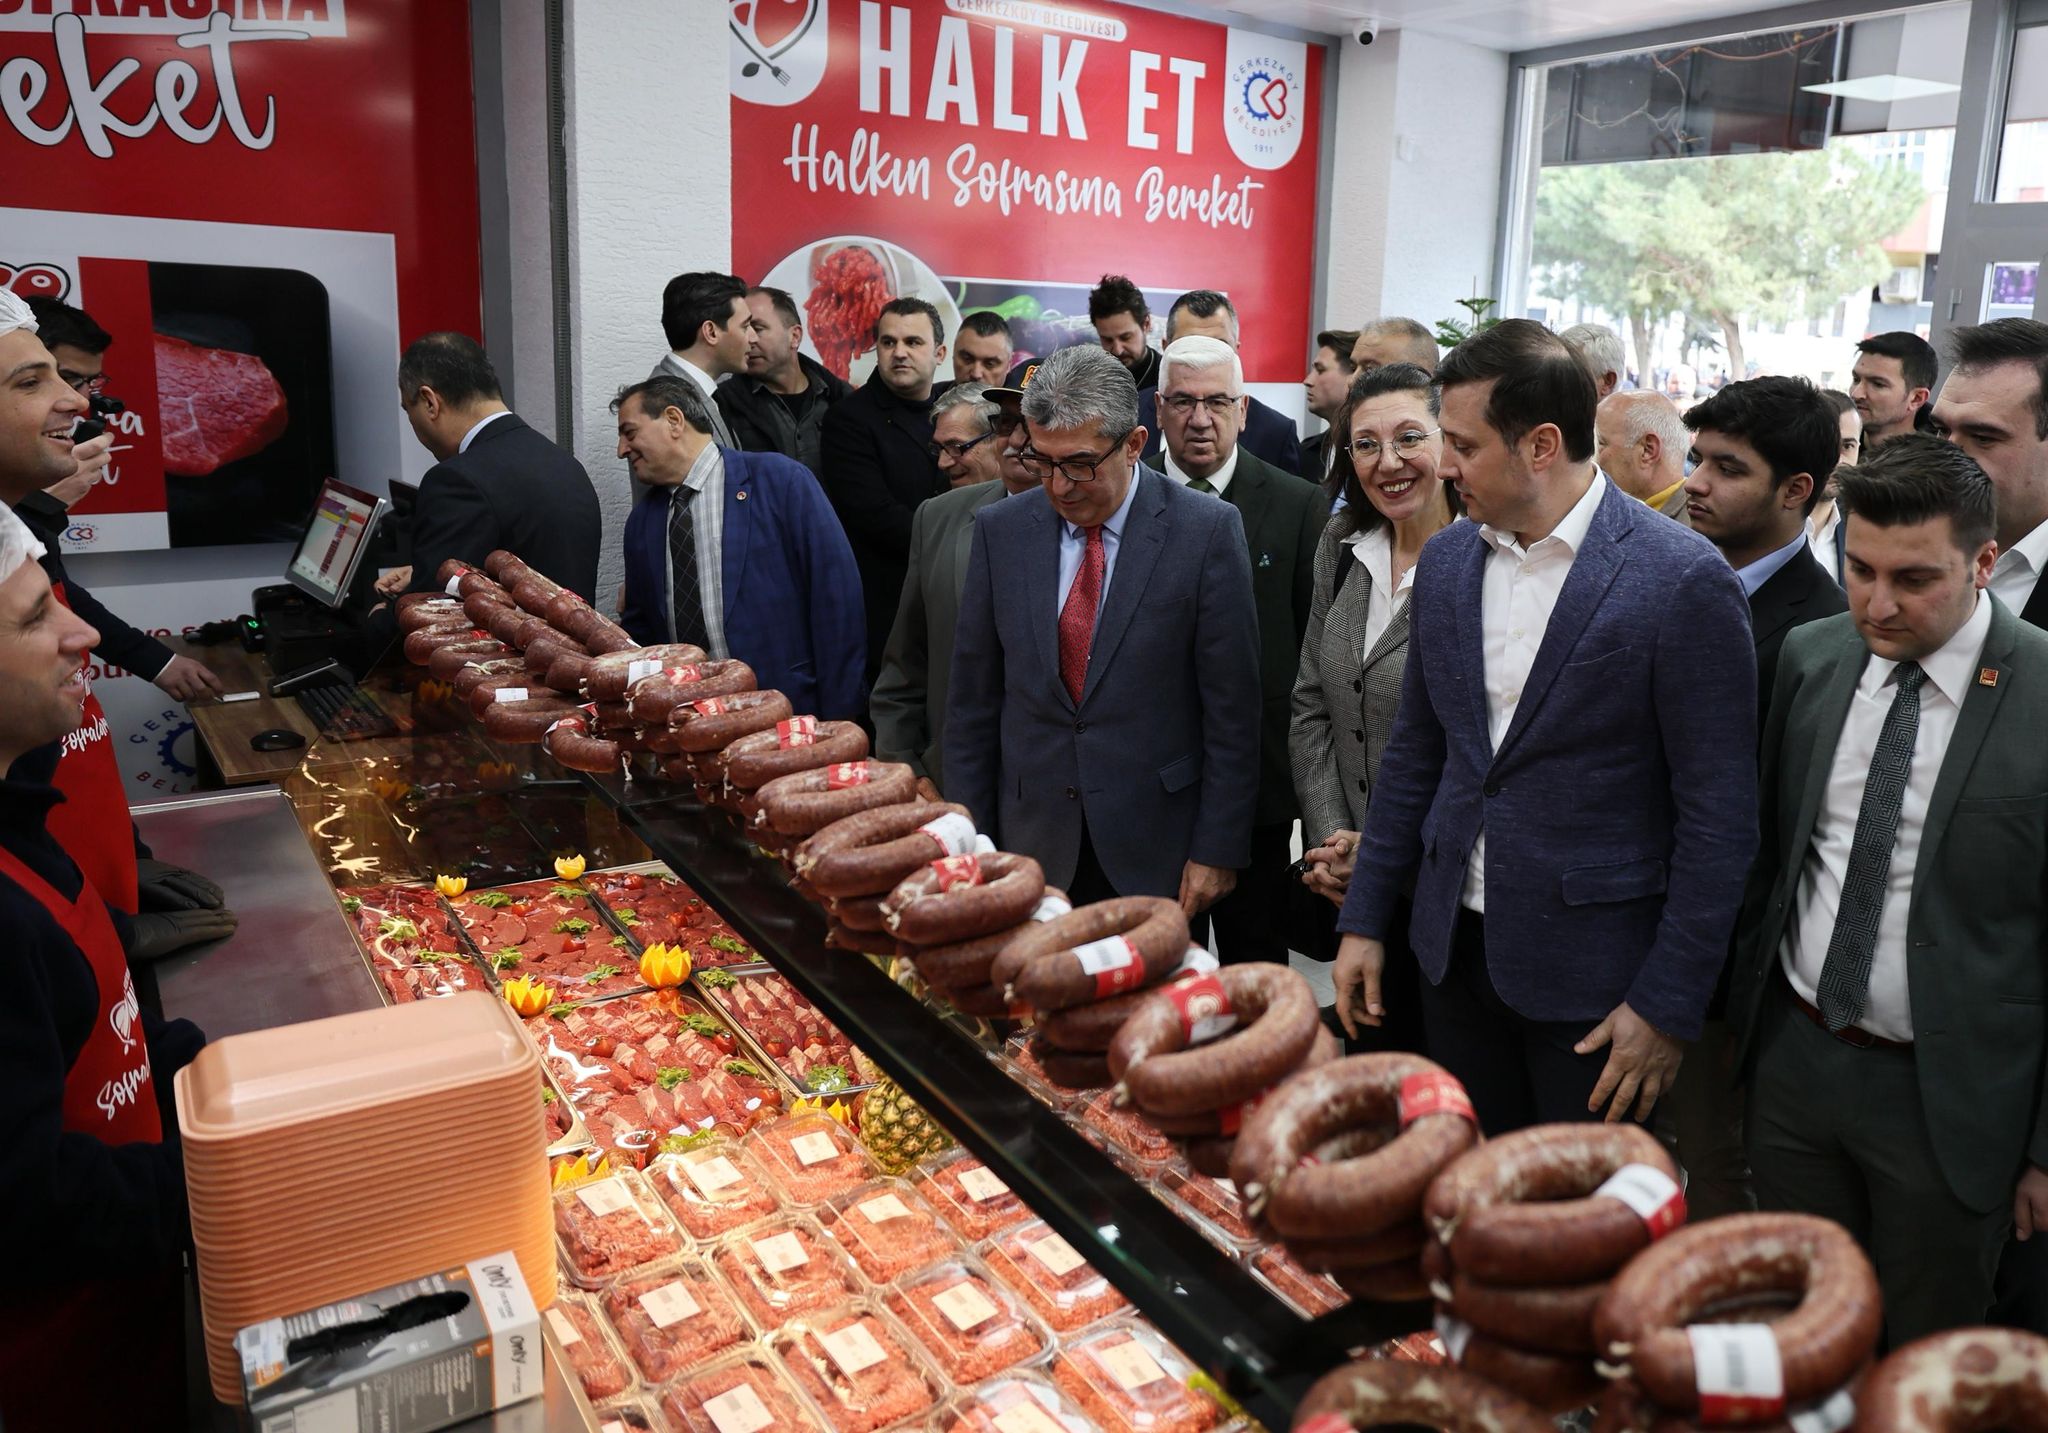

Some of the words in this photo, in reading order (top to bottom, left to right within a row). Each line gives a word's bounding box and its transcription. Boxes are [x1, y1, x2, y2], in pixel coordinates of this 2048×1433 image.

[859, 0, 1088, 141] HALK
[1127, 49, 1206, 155] ET
[783, 122, 930, 200] Halkın
[946, 143, 1121, 217] Sofrasına
[1135, 165, 1264, 229] Bereket
